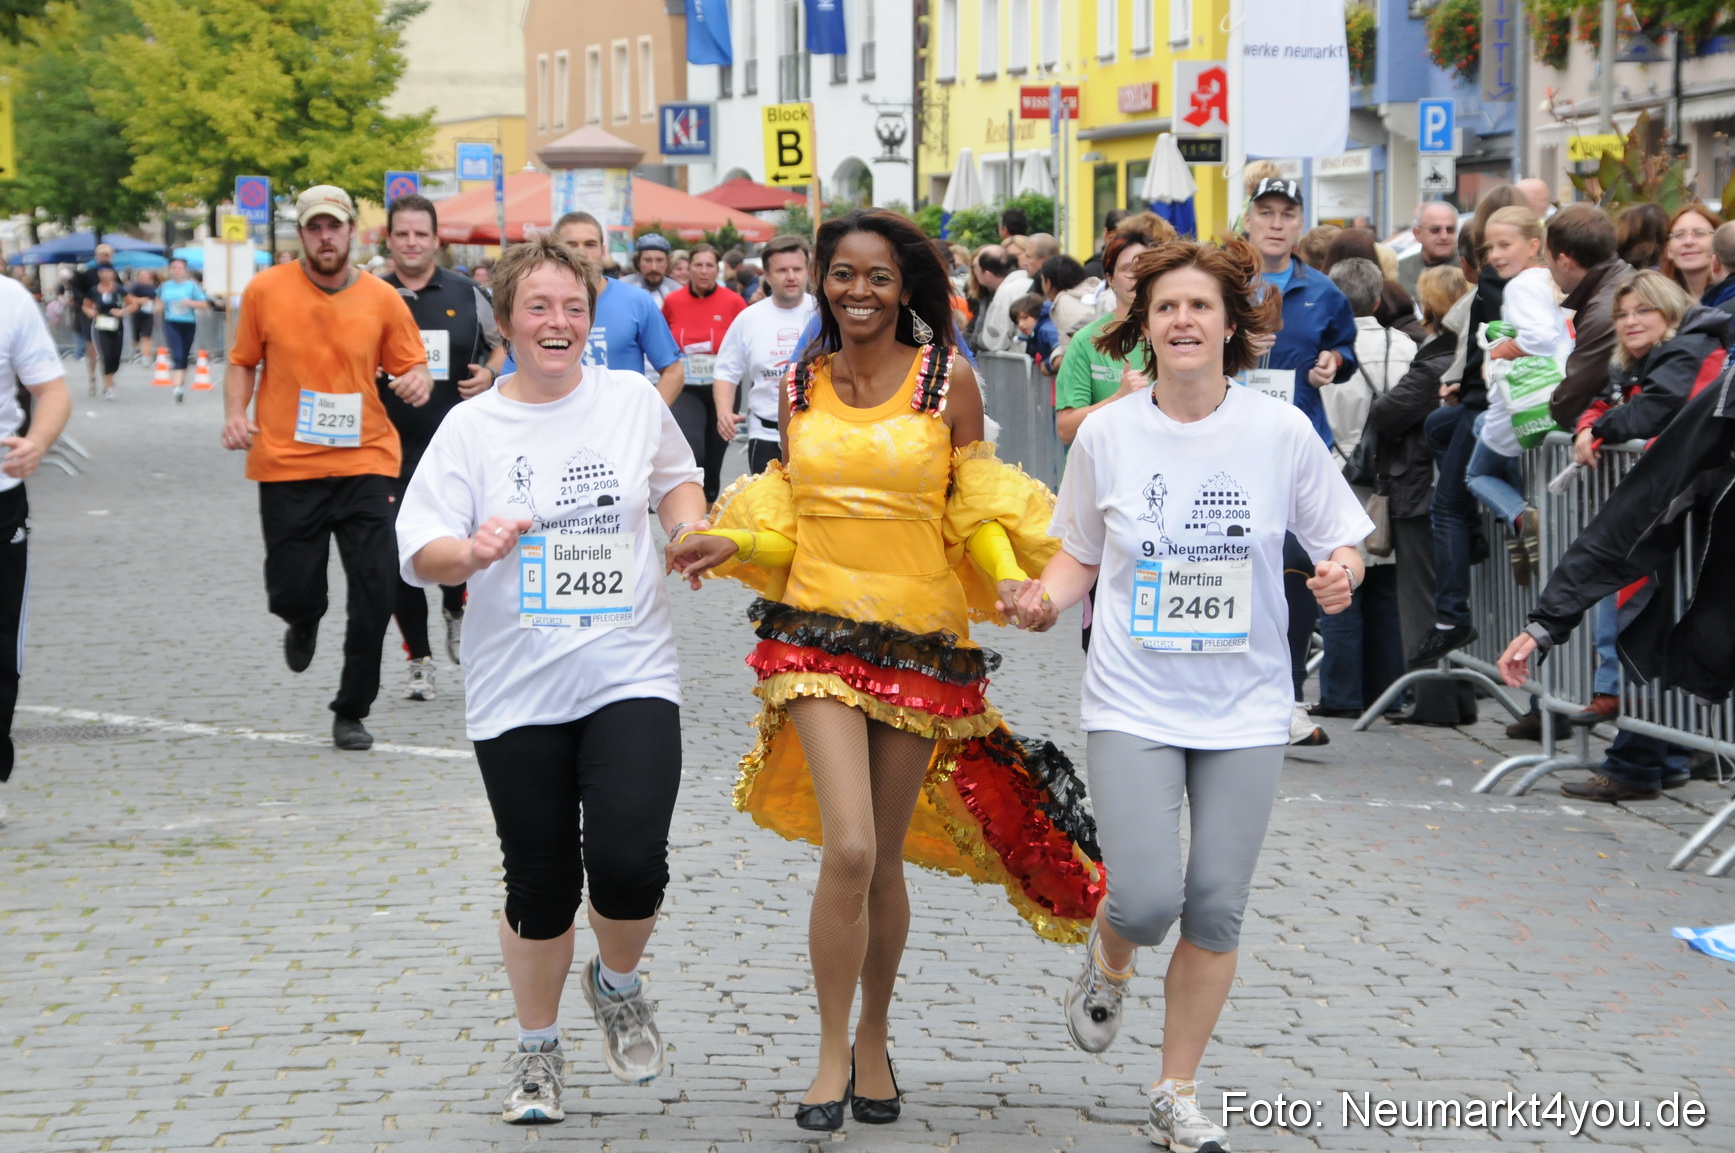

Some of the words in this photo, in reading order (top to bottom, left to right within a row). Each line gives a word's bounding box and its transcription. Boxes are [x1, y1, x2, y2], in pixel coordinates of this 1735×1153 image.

[1284, 44, 1346, 59] neumarkt
[767, 107, 809, 122] Block
[985, 117, 1036, 144] Resturant
[777, 129, 803, 167] B
[1250, 375, 1271, 384] Janni
[318, 398, 334, 409] Alex
[317, 413, 354, 428] 2279
[560, 478, 619, 496] 21.09.2008
[541, 513, 620, 530] Neumarkter
[1191, 509, 1251, 520] 21.09.2008
[554, 543, 612, 561] Gabriele
[1141, 540, 1163, 558] 9.
[1168, 543, 1250, 556] Neumarkter
[1187, 553, 1249, 563] Stdtlf
[528, 569, 535, 582] C
[555, 570, 623, 596] 2482
[1168, 571, 1222, 587] Martina
[1141, 593, 1148, 606] C
[1167, 596, 1235, 619] 2461
[592, 613, 633, 622] PFLEIDERER
[1204, 639, 1247, 648] PFLEIDERER
